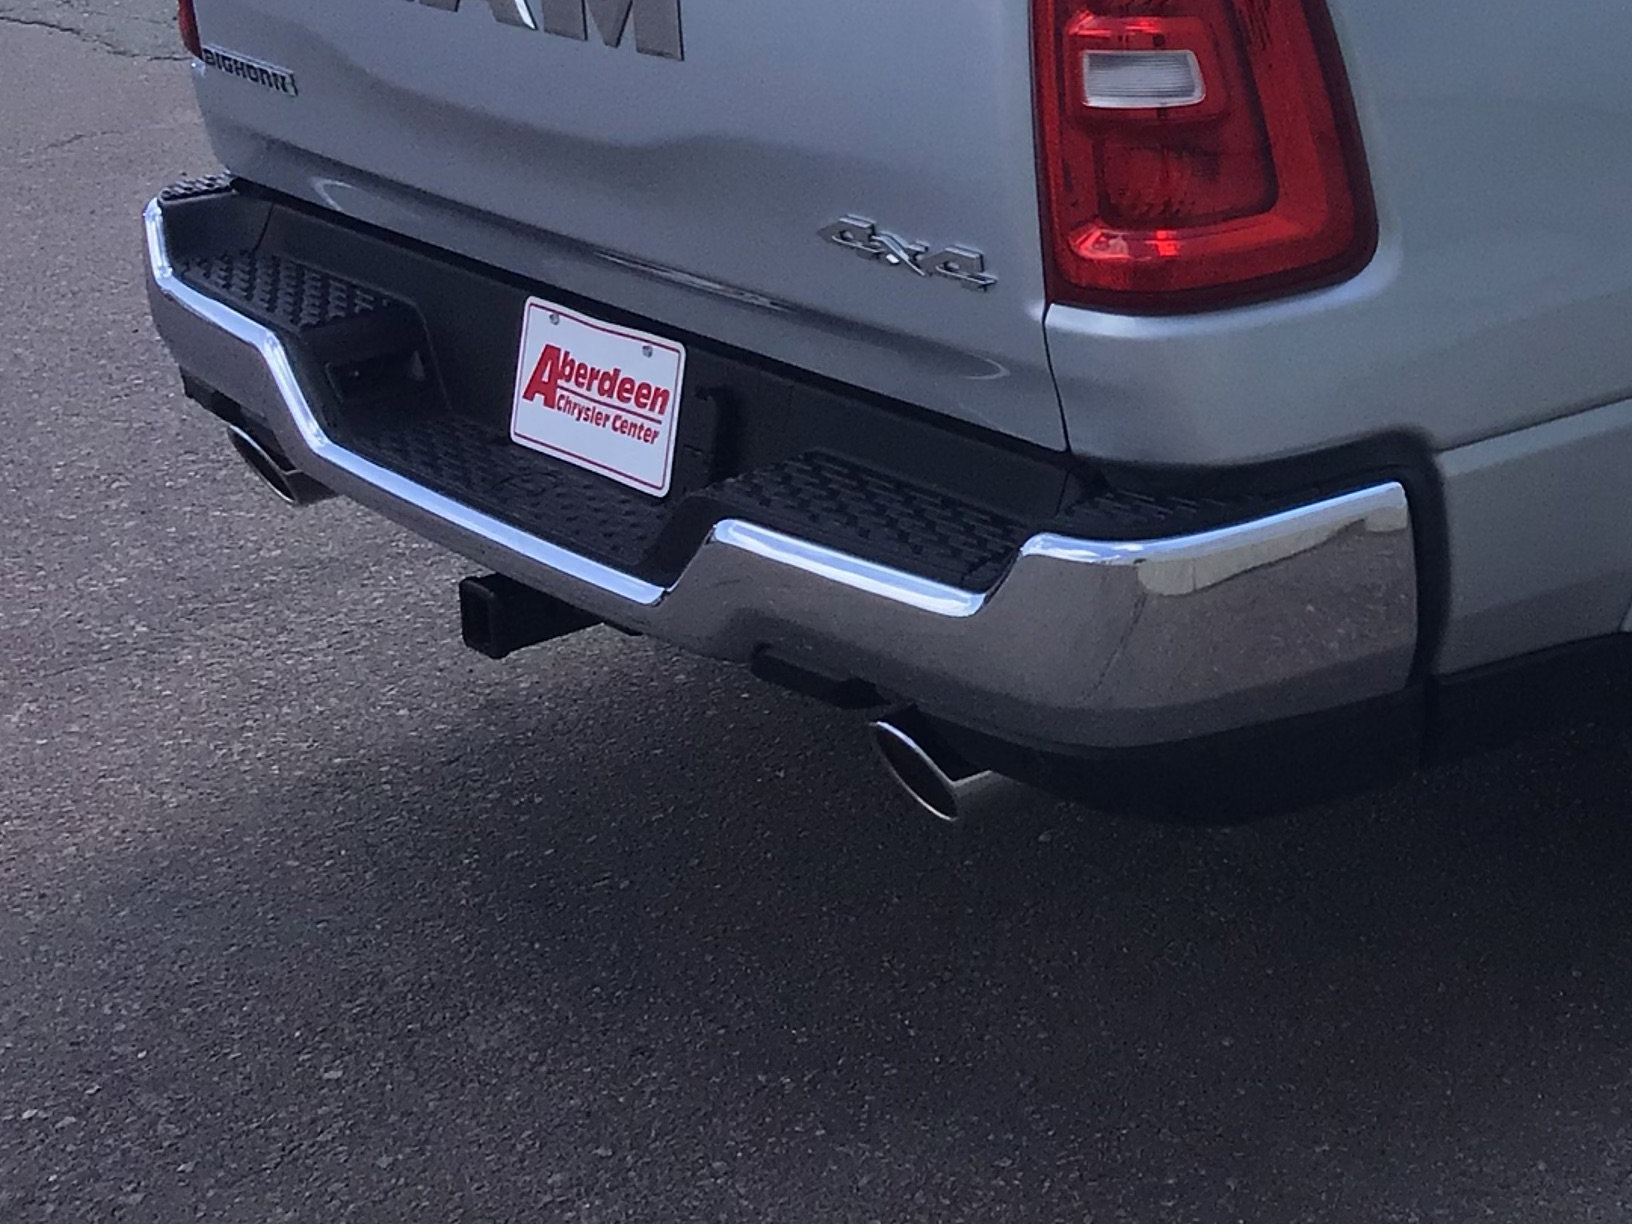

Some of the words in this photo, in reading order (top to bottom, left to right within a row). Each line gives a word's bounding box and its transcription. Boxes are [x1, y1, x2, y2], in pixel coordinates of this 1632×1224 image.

[522, 343, 670, 416] Aberdeen
[556, 393, 611, 429] Chrysler
[611, 413, 660, 445] Center
